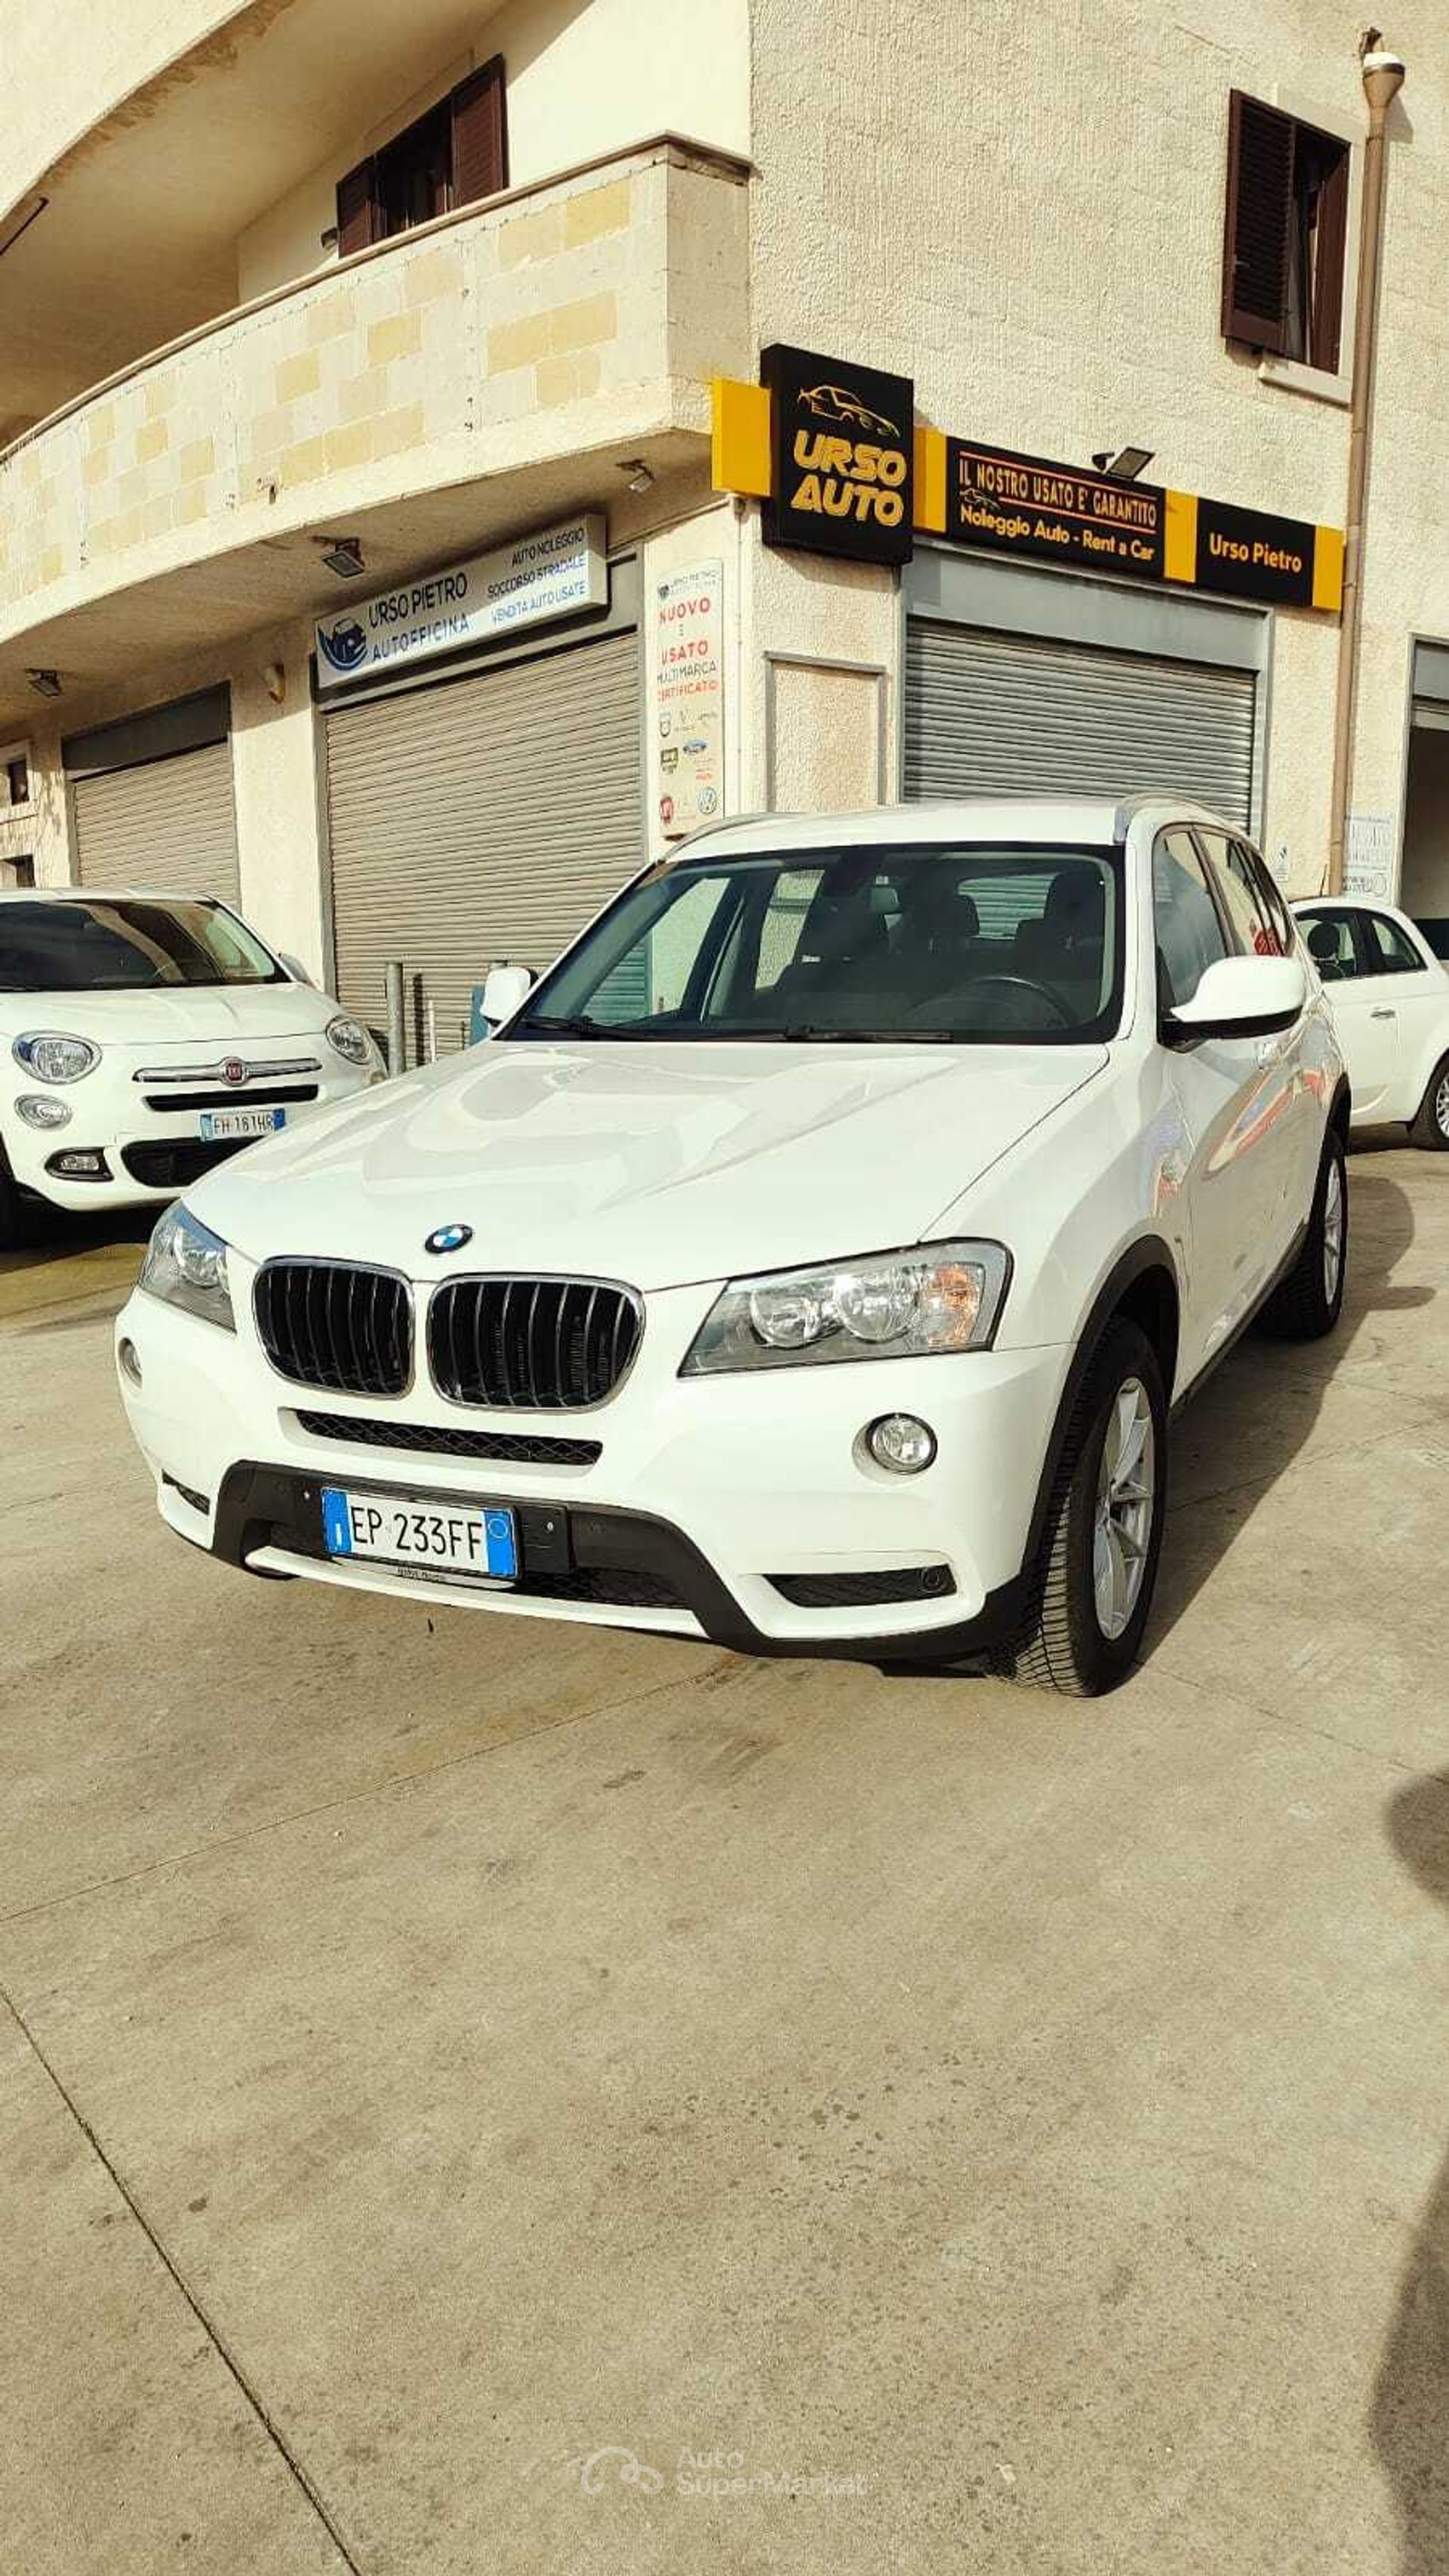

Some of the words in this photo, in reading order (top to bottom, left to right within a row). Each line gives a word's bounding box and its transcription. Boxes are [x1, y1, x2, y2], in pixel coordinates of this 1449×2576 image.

[794, 429, 906, 487] URSO
[790, 474, 904, 526] AUTO
[959, 459, 971, 485] IL
[977, 464, 1029, 500] NOSTRO
[1033, 477, 1074, 508] USATO
[1094, 491, 1157, 527] GARANTITO
[512, 546, 536, 568] AUTO
[537, 528, 585, 556] NOLEGGIO
[961, 505, 1030, 537] Noleggio
[1034, 520, 1070, 543] Auto
[1083, 531, 1115, 553] Rent
[1118, 543, 1127, 556] a
[1131, 539, 1155, 561] Car
[1210, 532, 1249, 561] Urso
[1253, 542, 1302, 573] Pietro
[488, 570, 536, 599] SOCCORSO
[537, 553, 586, 580] STRADALE
[368, 594, 408, 628] URSO
[411, 573, 468, 614] PIETRO
[491, 599, 528, 625] VENDITA
[530, 591, 554, 610] AUTO
[555, 580, 586, 602] USATE
[660, 597, 711, 625] NUOVO
[373, 613, 469, 661] AUTOFFICINA
[661, 641, 708, 664] USATO
[657, 660, 717, 684] MULTIMARCA
[351, 1507, 382, 1545] EP
[394, 1513, 483, 1559] 233FF
